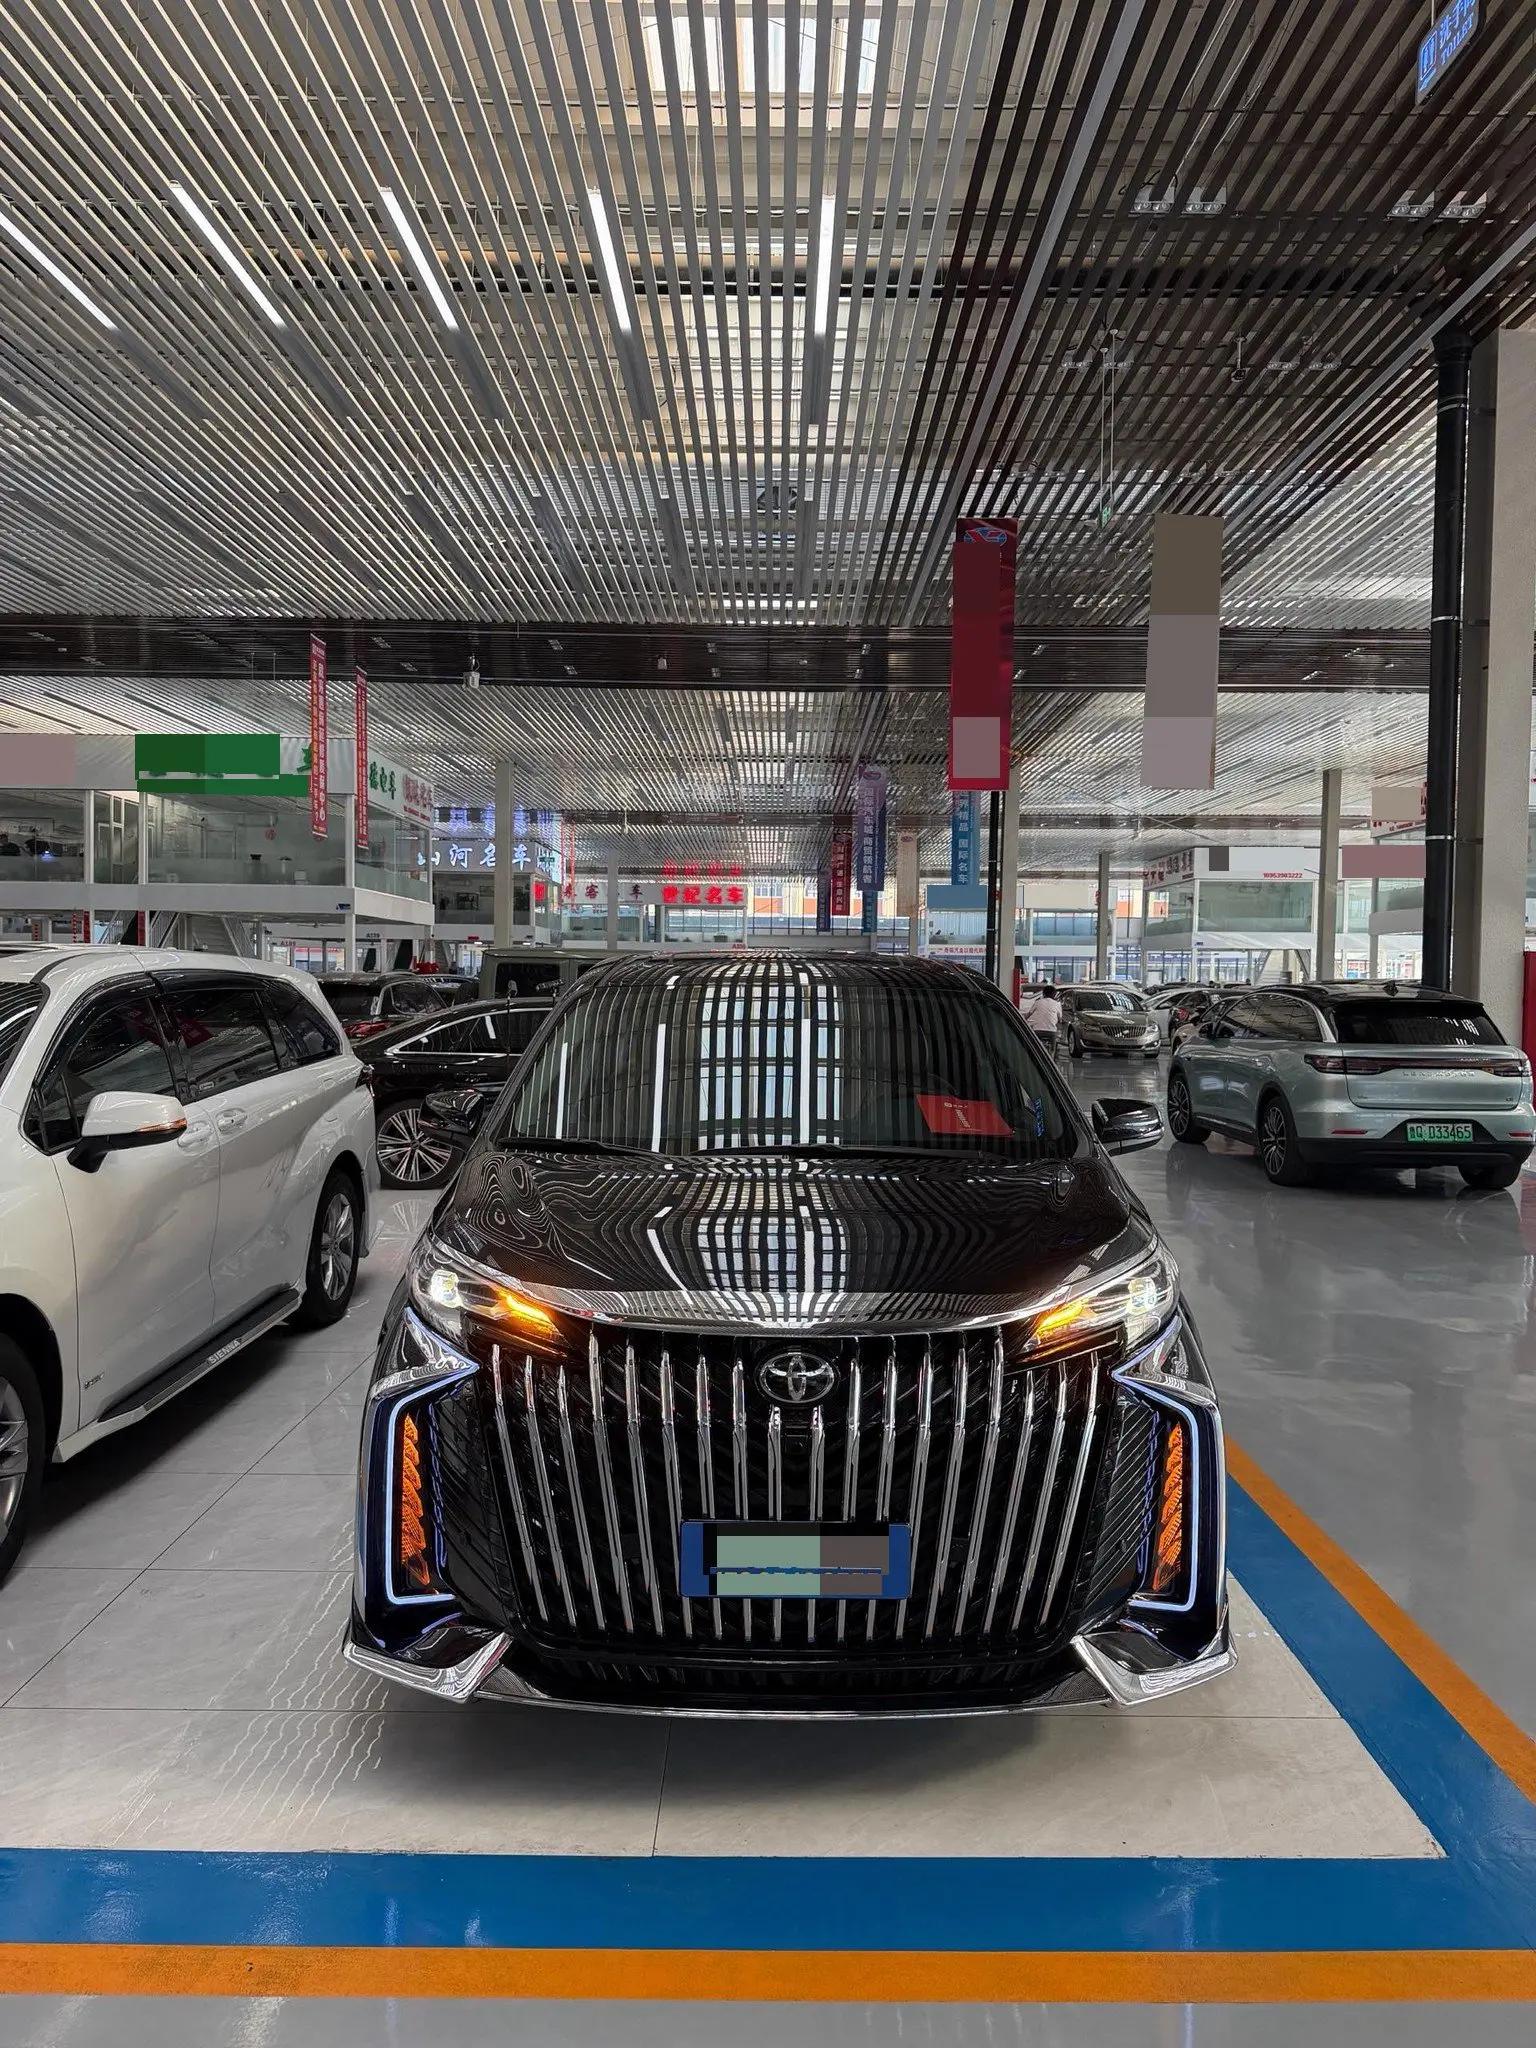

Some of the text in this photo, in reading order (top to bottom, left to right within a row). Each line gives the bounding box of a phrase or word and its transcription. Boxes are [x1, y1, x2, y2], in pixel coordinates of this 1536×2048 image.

[957, 838, 969, 884] 国际名车
[208, 1337, 242, 1365] SIENNA
